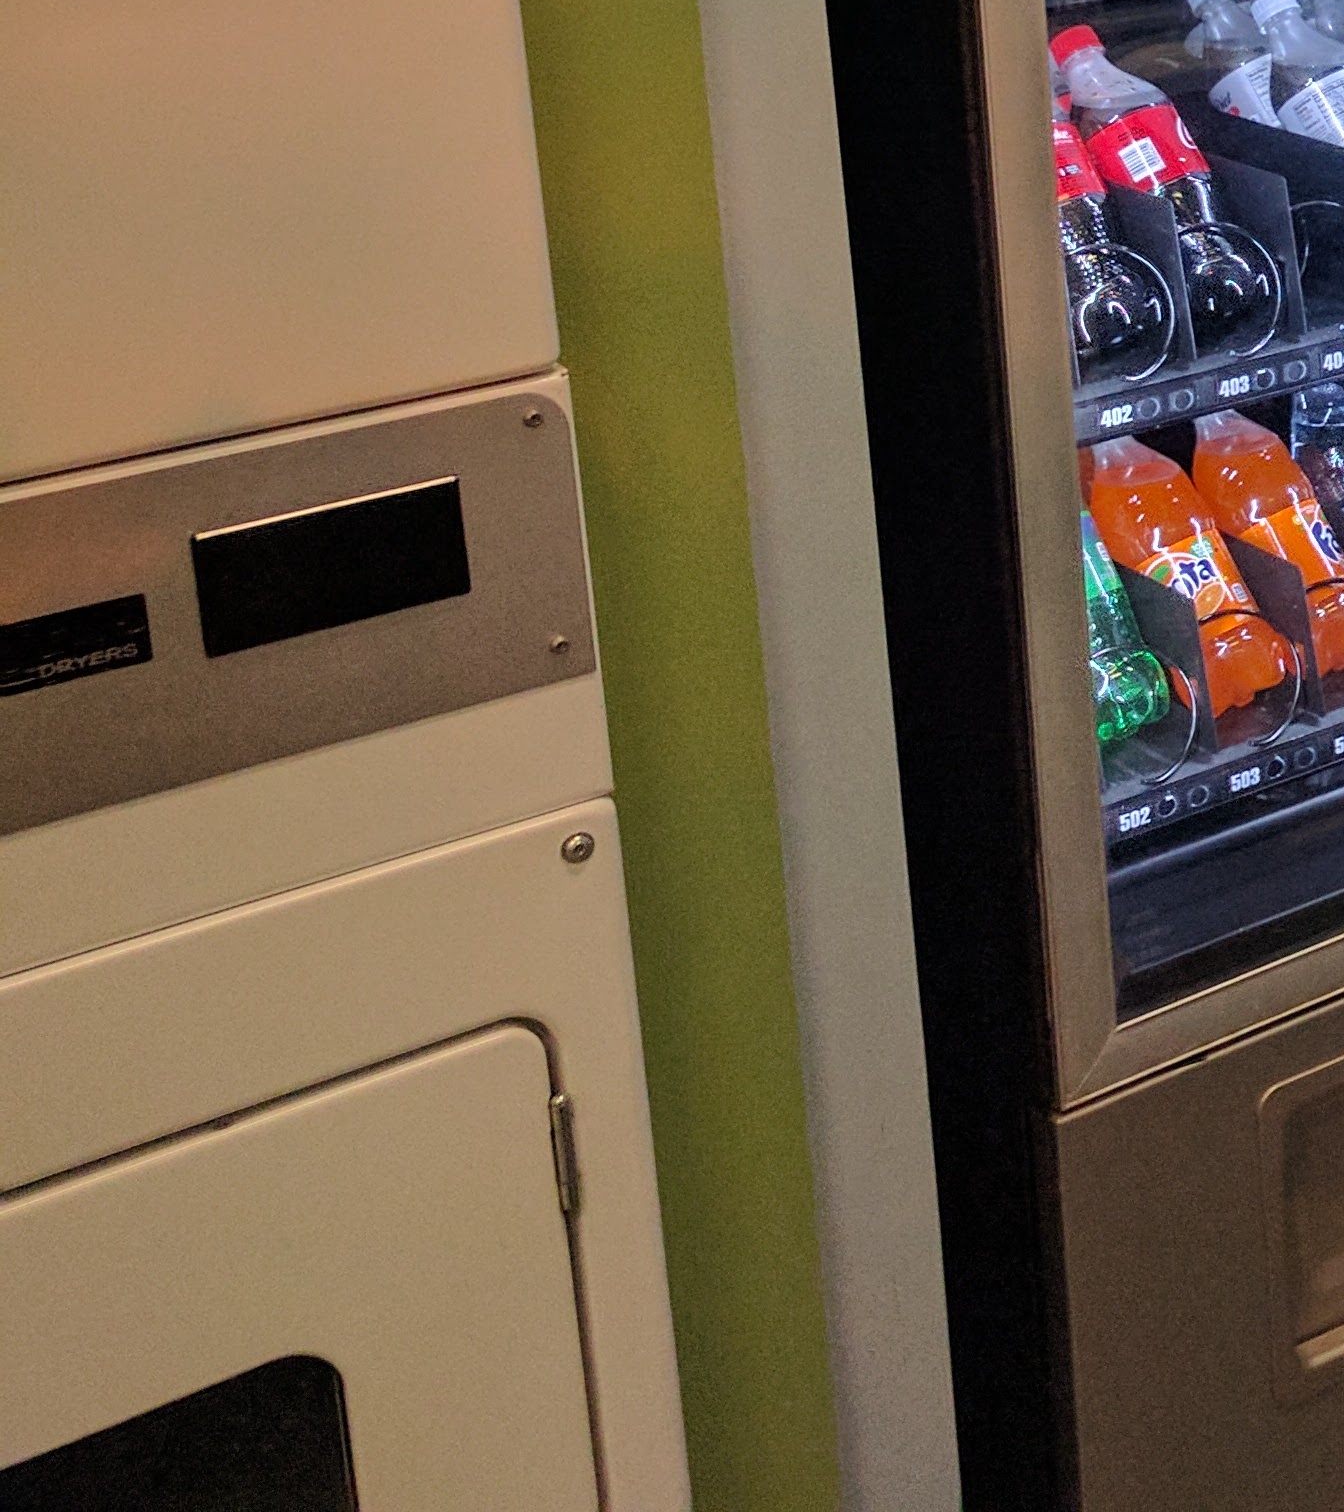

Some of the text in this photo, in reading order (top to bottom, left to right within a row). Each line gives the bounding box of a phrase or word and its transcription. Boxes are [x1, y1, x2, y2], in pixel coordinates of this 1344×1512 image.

[1219, 373, 1251, 397] 403
[1101, 404, 1134, 428] 402
[38, 643, 139, 679] DRYERS
[1230, 766, 1262, 792] 503
[1119, 806, 1152, 832] 502
